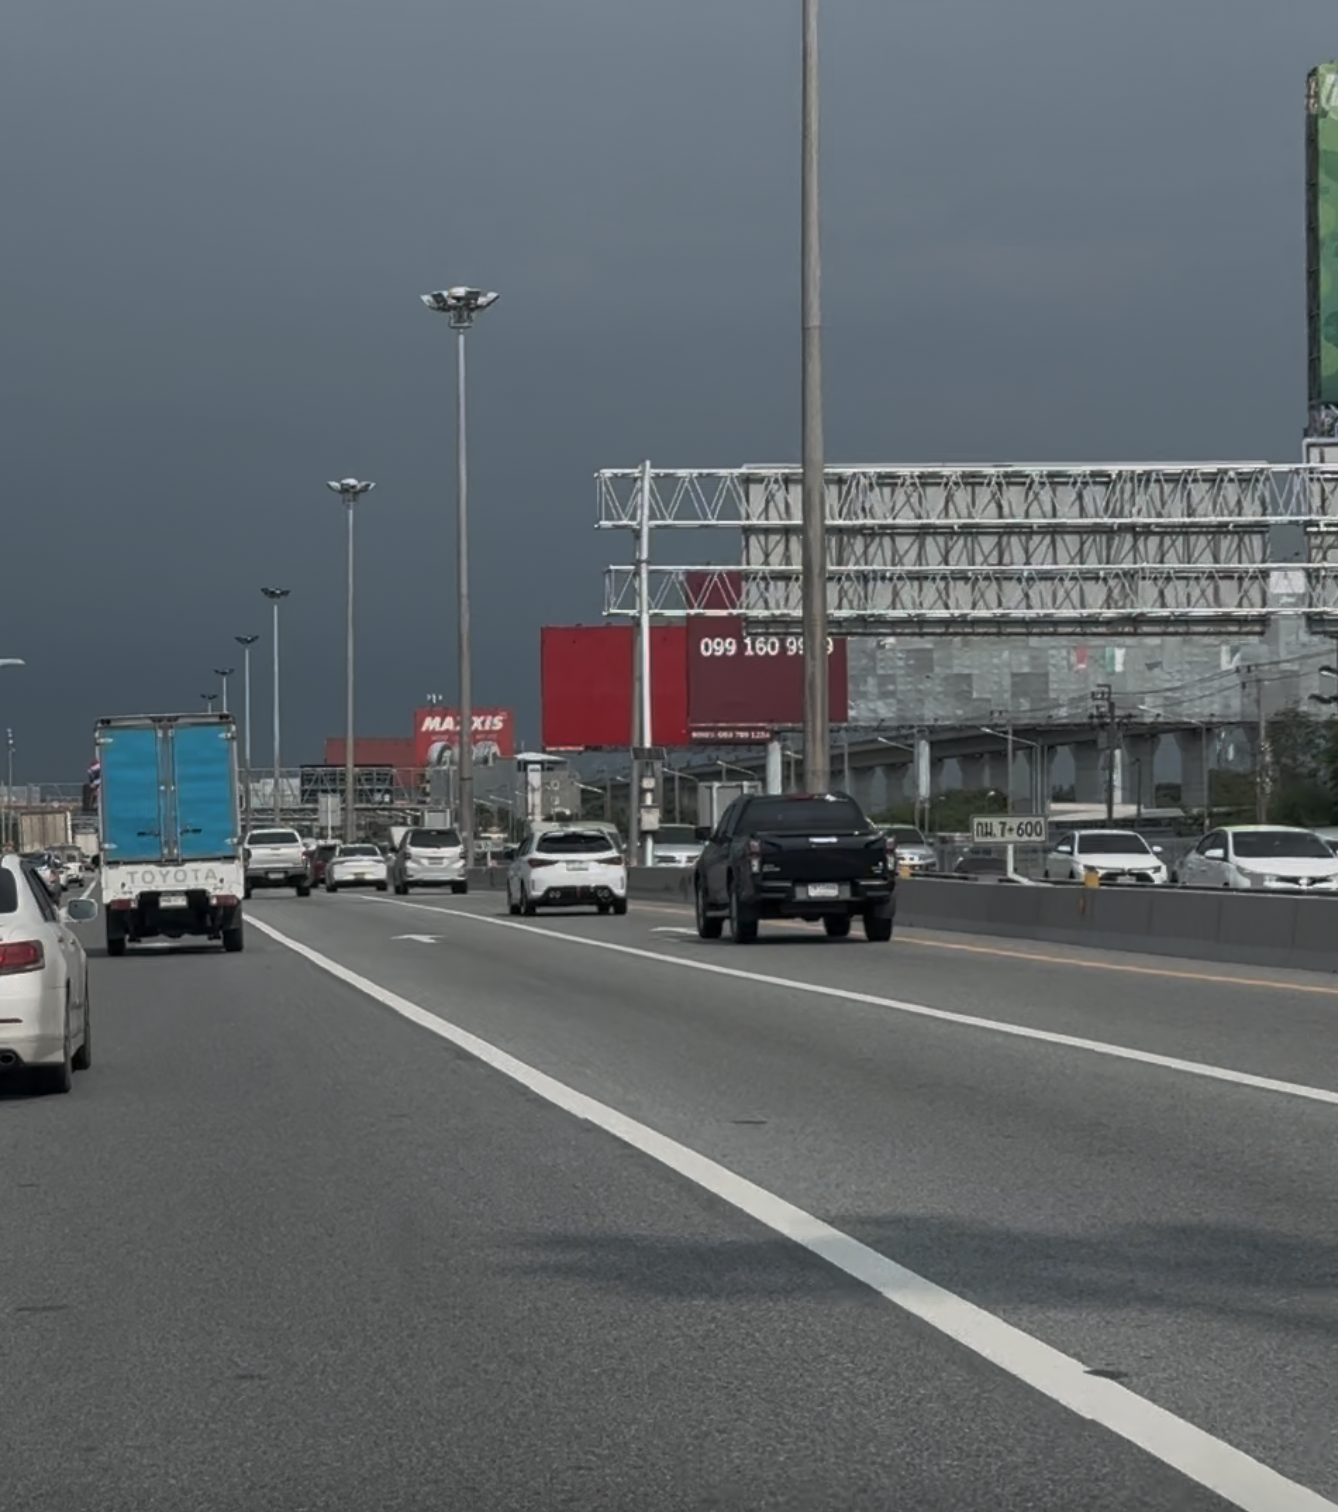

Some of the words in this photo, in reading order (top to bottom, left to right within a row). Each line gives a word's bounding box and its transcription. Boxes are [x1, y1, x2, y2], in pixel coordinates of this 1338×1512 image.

[700, 637, 737, 656] 099
[744, 637, 780, 656] 160
[126, 868, 218, 885] TOYOTA
